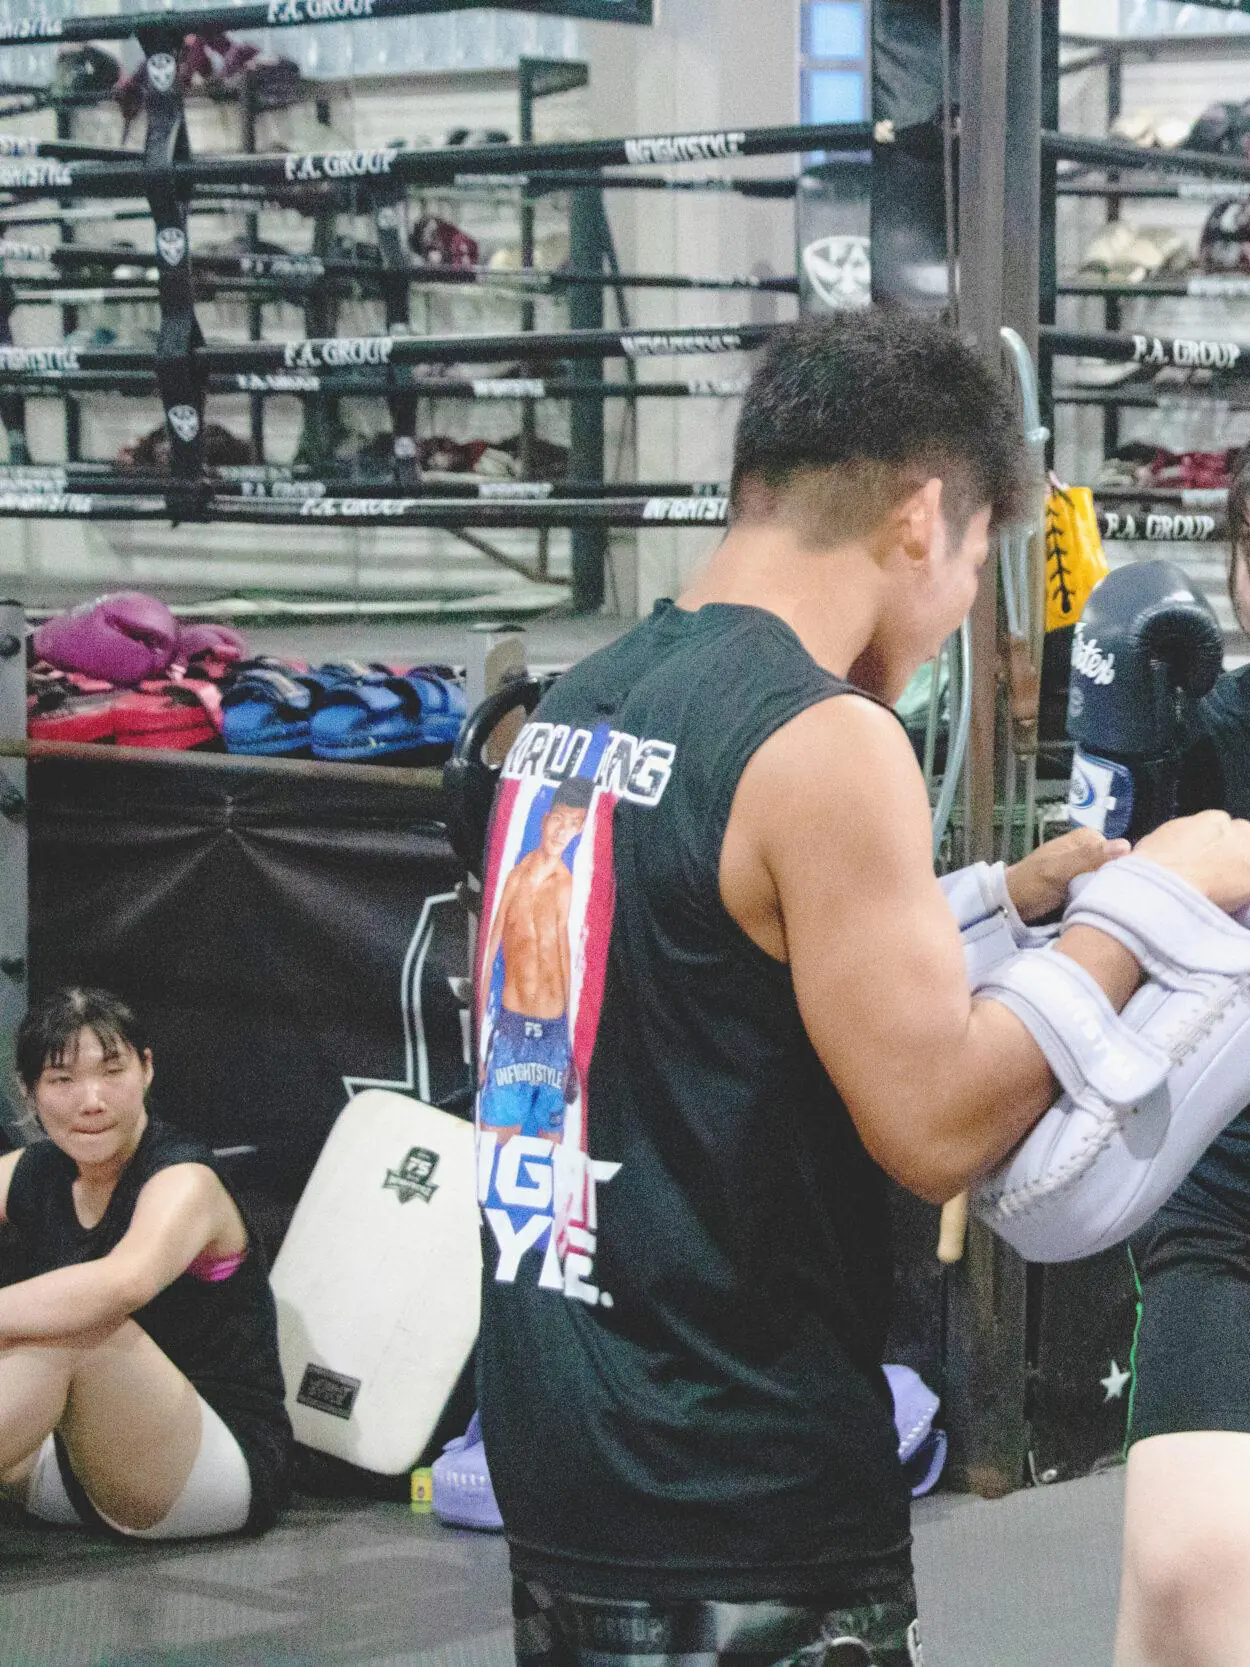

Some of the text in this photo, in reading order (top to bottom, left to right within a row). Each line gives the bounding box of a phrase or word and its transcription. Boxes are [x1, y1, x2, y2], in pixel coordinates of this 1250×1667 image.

[322, 148, 397, 178] GROUP
[322, 338, 393, 365] GROUP
[1173, 339, 1241, 369] GROUP
[1146, 514, 1215, 541] GROUP
